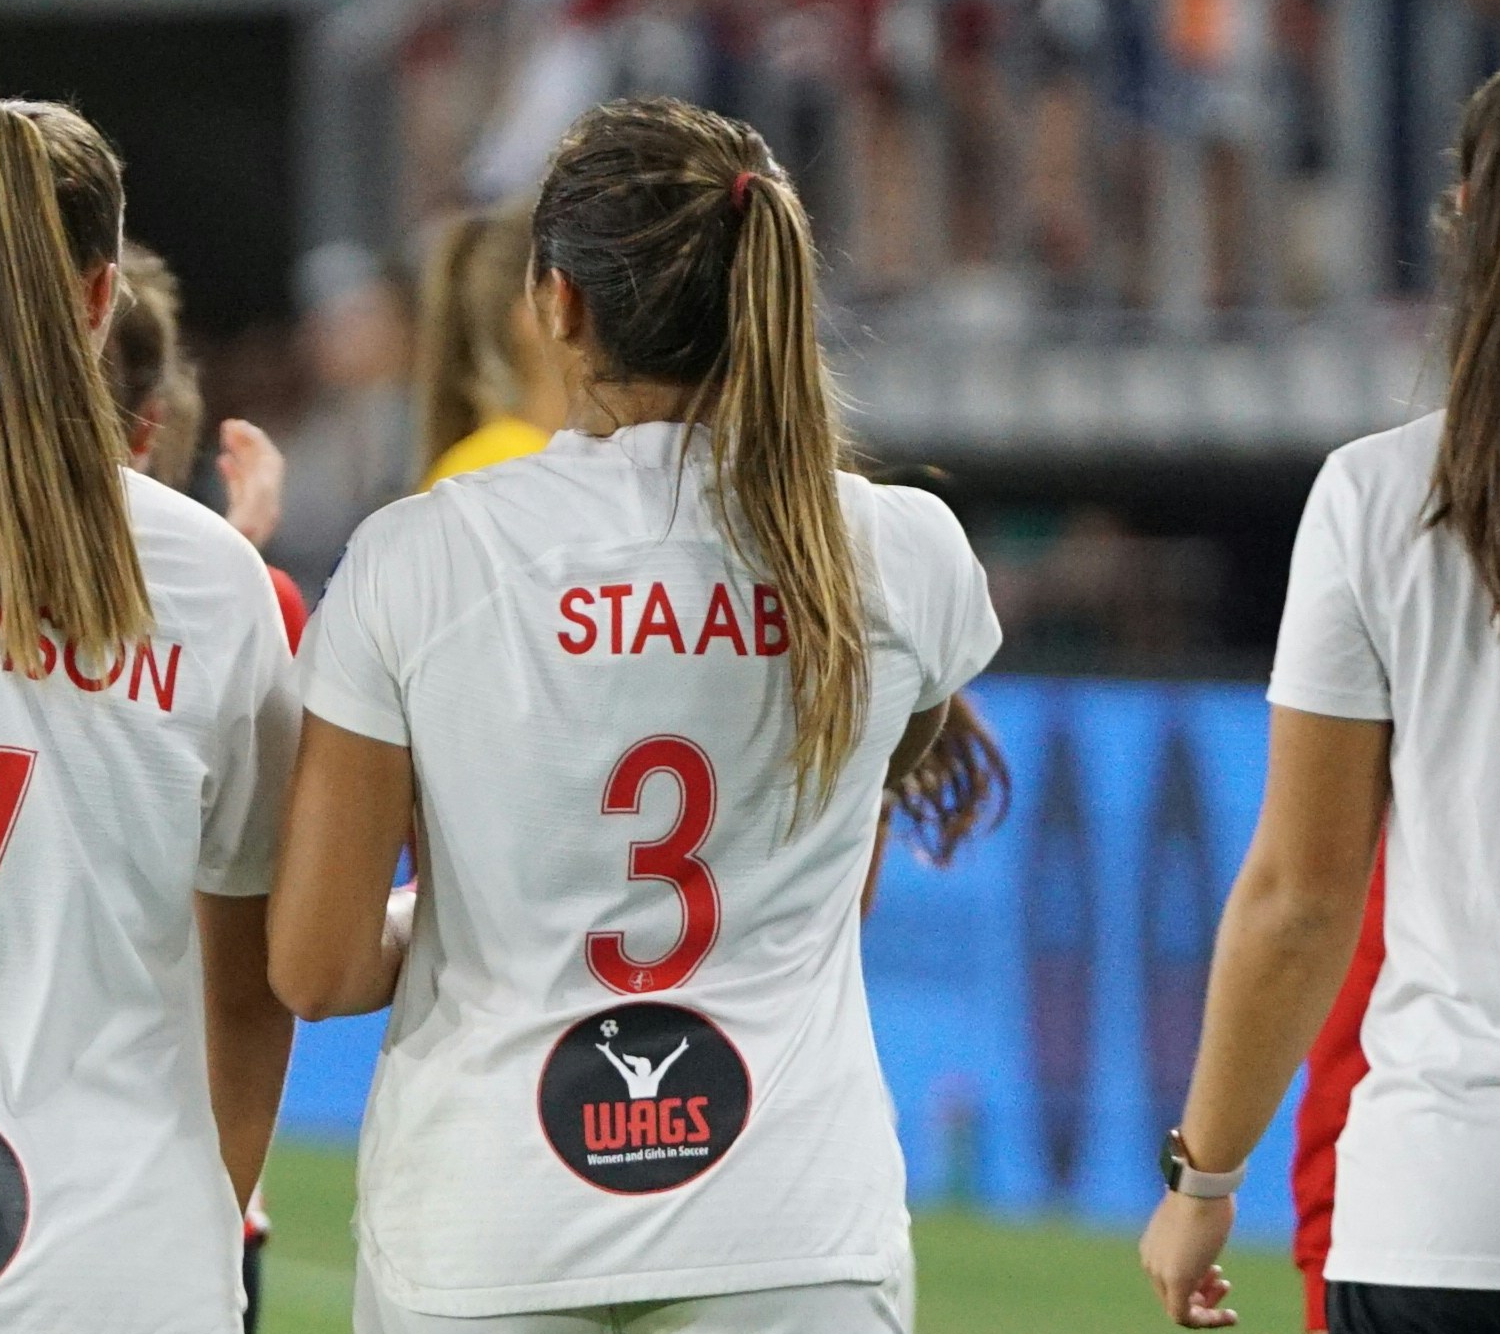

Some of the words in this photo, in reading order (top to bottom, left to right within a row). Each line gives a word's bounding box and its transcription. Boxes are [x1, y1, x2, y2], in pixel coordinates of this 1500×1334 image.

[557, 582, 793, 658] STAAB
[585, 733, 721, 996] 3
[583, 1096, 711, 1151] WAGS
[587, 1153, 624, 1166] Women
[625, 1149, 643, 1162] and
[644, 1147, 666, 1160] Girls
[678, 1144, 709, 1157] Soccer
